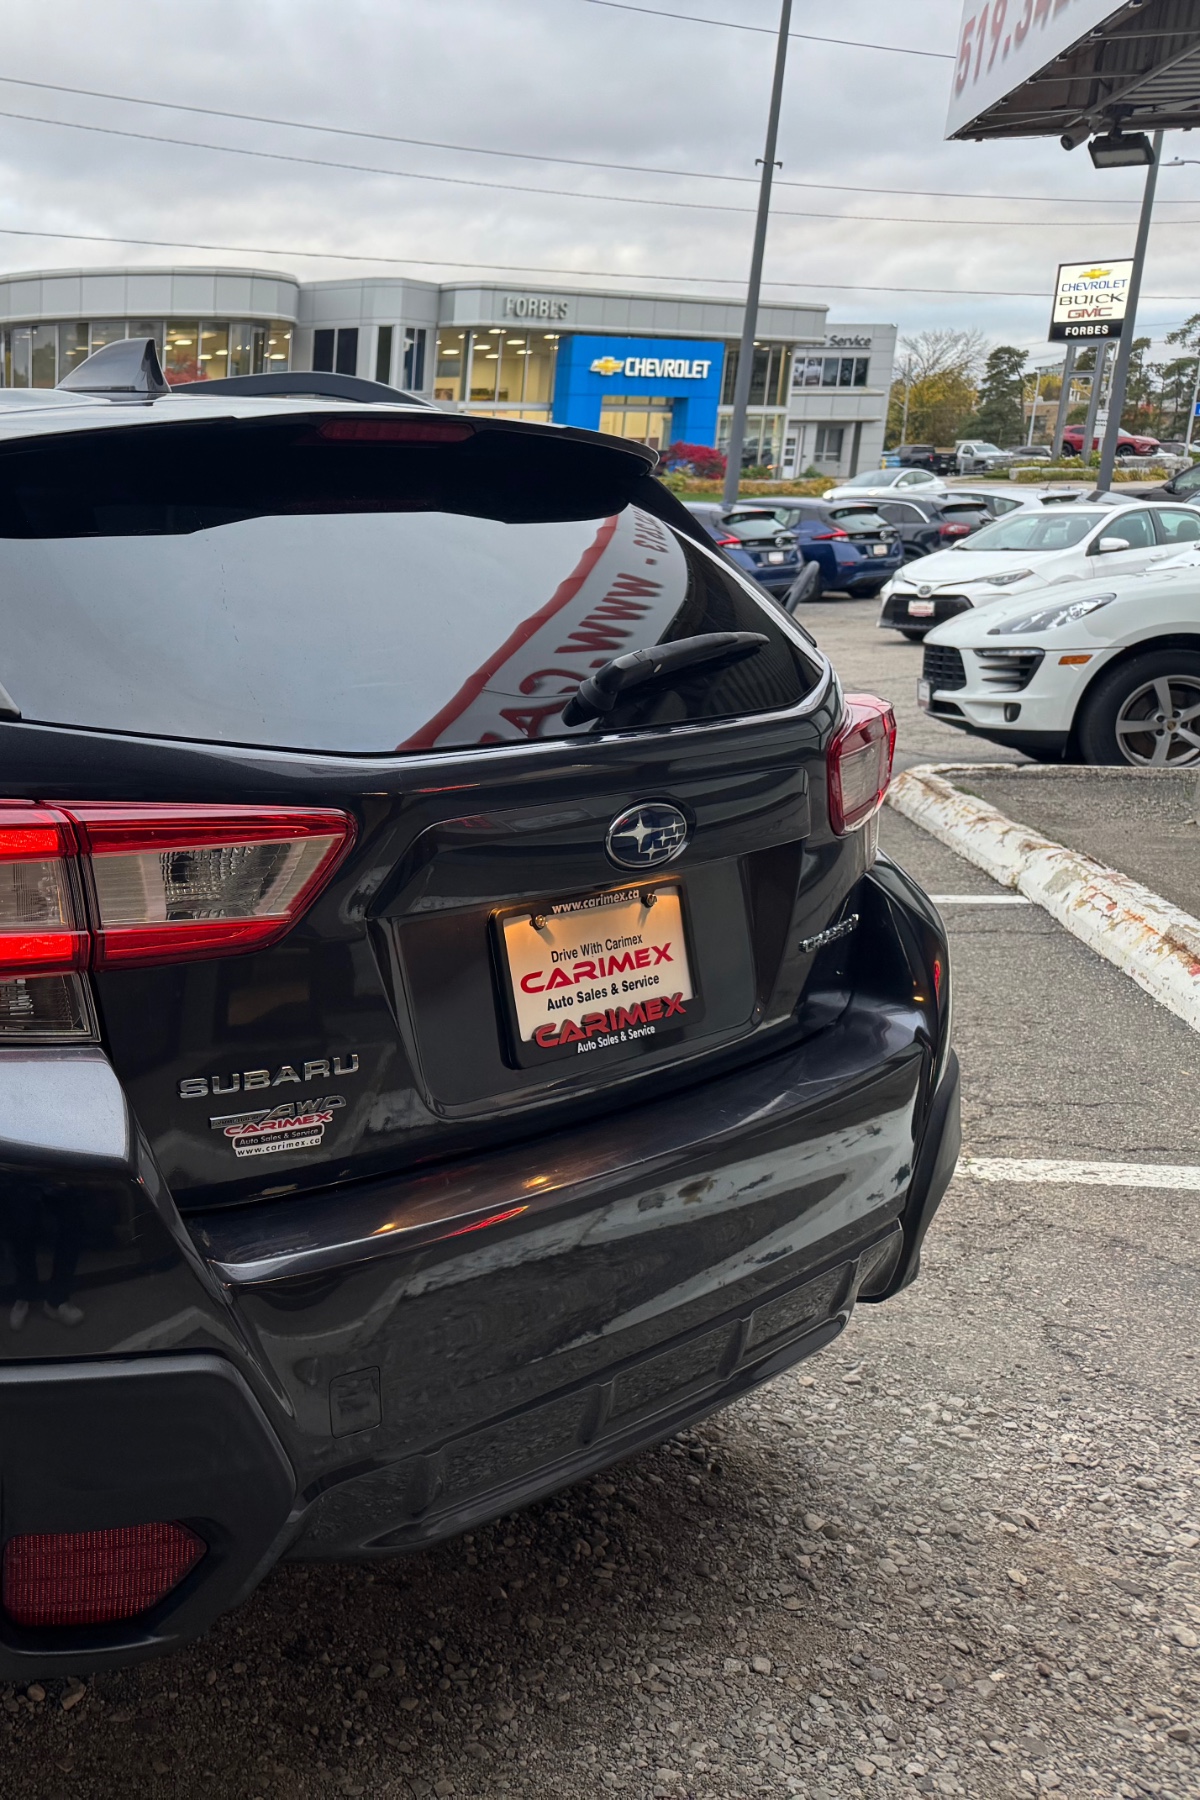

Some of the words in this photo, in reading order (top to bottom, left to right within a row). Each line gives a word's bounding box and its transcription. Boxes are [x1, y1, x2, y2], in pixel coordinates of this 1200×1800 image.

[1062, 279, 1128, 292] CHEVROLET
[505, 297, 569, 320] FORBES
[1059, 292, 1125, 306] BUICK
[1067, 307, 1113, 319] GMC
[829, 334, 872, 348] Service
[1065, 325, 1109, 336] FORBES
[625, 356, 712, 379] CHEVROLET
[551, 889, 640, 914] www.carimex.ca
[551, 949, 579, 963] Drive
[580, 941, 603, 957] With
[605, 933, 643, 952] Carimex
[520, 942, 674, 994] CARIMEX
[547, 994, 574, 1012] Auto
[577, 986, 608, 1004] Sales
[611, 983, 619, 996] &
[622, 973, 660, 993] Service
[533, 992, 687, 1049] CARIMEX
[577, 1037, 597, 1054] Auto
[598, 1032, 619, 1049] Sales
[620, 1030, 628, 1041] &
[628, 1024, 656, 1040] Service
[179, 1053, 360, 1099] SUBARU
[264, 1095, 347, 1121] AWD
[225, 1110, 333, 1136] CARIMEX
[237, 1137, 321, 1157] www.carimex.ca
[240, 1137, 259, 1147] Auto
[260, 1134, 282, 1143] Sales
[291, 1127, 319, 1138] Service
